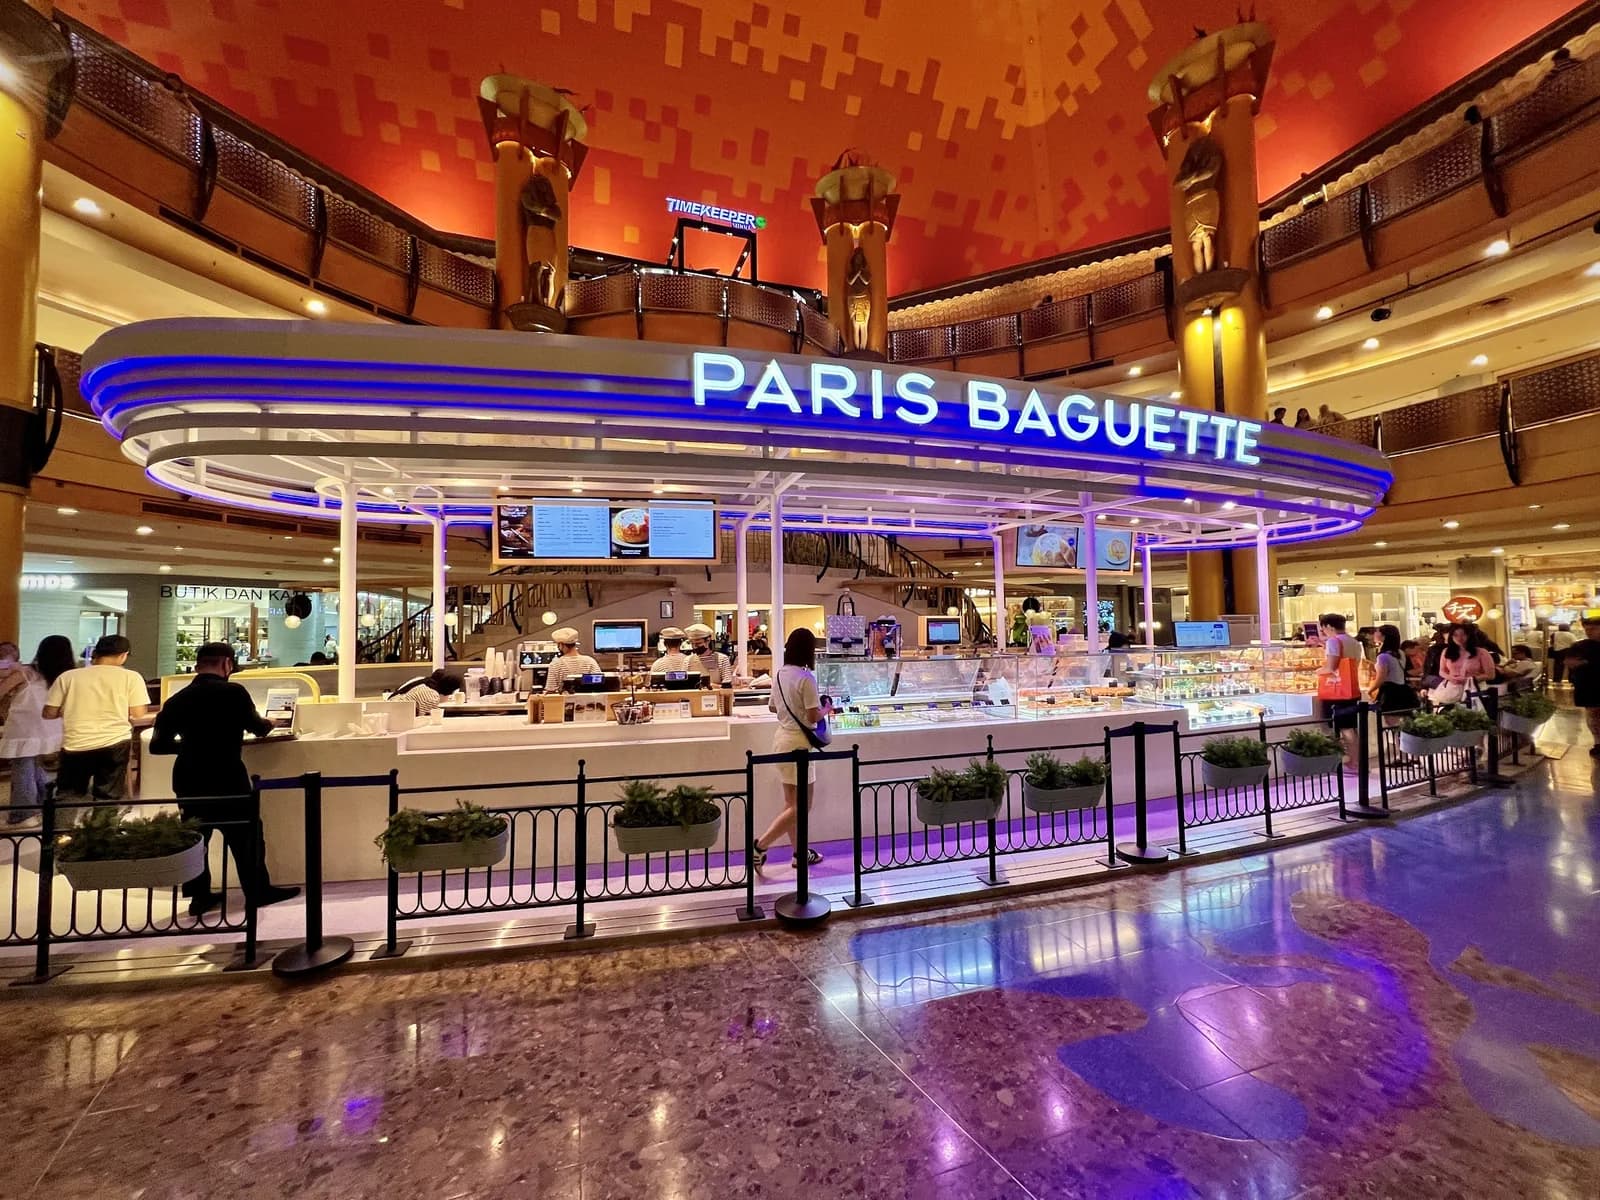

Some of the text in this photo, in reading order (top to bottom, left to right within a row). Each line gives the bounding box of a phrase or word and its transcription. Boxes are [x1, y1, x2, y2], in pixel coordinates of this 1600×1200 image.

[665, 197, 756, 229] TIMEKEEPER
[692, 352, 1263, 466] PARIS BAGUETTE
[160, 585, 219, 600] BUTIK
[224, 587, 262, 601] DAN
